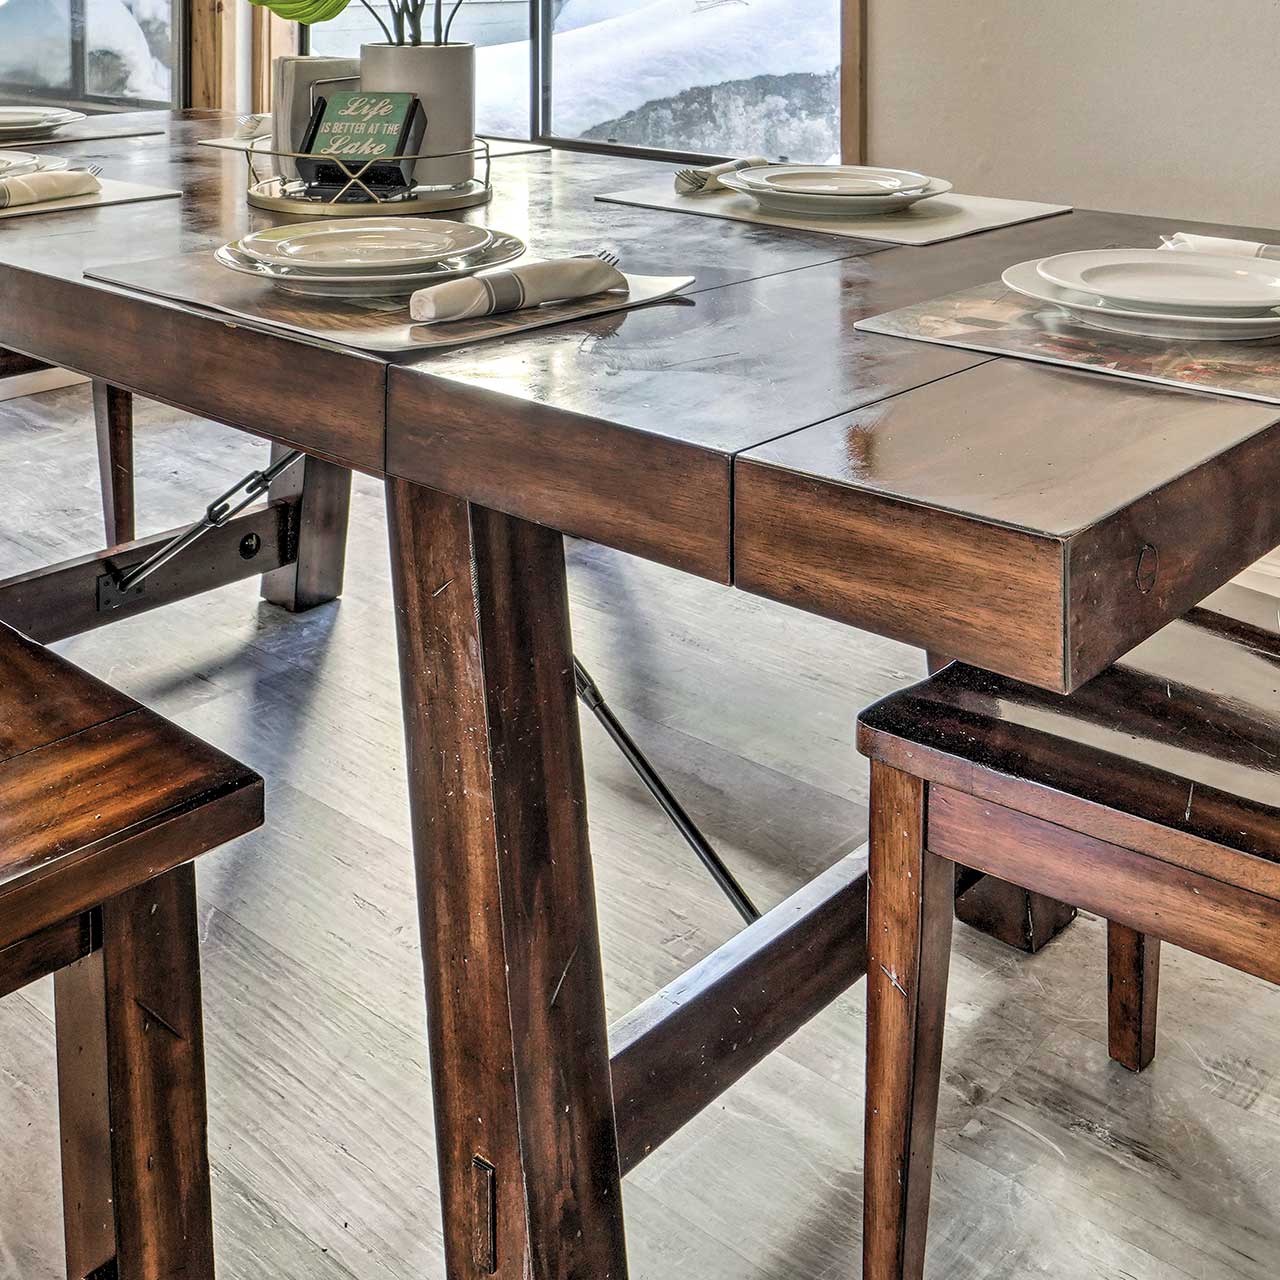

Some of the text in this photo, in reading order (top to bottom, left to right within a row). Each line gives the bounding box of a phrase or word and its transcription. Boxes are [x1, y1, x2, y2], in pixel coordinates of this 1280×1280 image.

[338, 96, 393, 122] Life
[320, 122, 400, 135] IS BETTER AT THE
[320, 135, 387, 155] Lake
